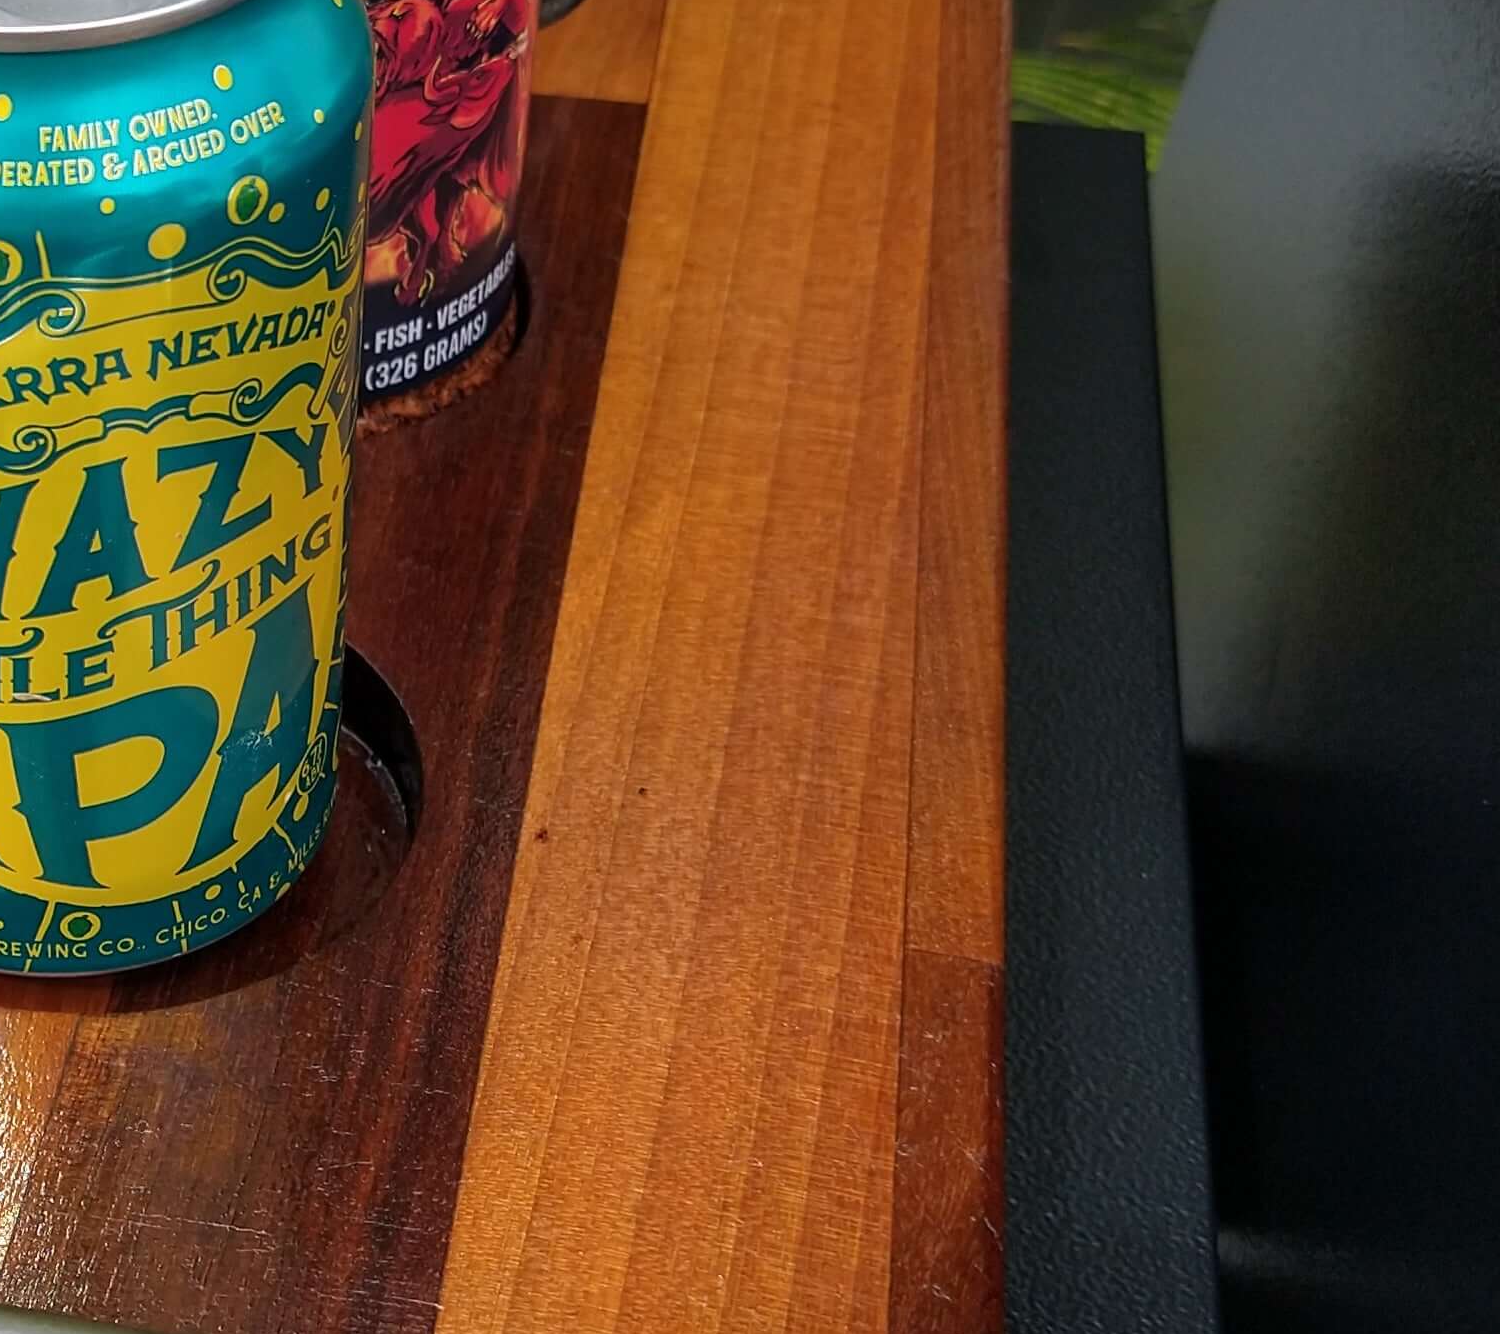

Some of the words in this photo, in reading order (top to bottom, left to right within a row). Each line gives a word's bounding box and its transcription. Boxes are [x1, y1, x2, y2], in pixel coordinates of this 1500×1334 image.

[38, 119, 120, 152] FAMILY
[102, 151, 128, 181] &
[133, 129, 225, 176] ARGUED
[230, 101, 286, 145] OVER
[365, 351, 418, 391] (326
[424, 310, 488, 372] GRAMS)
[374, 316, 423, 354] FISH
[97, 513, 335, 673] THING
[238, 886, 262, 910] CA
